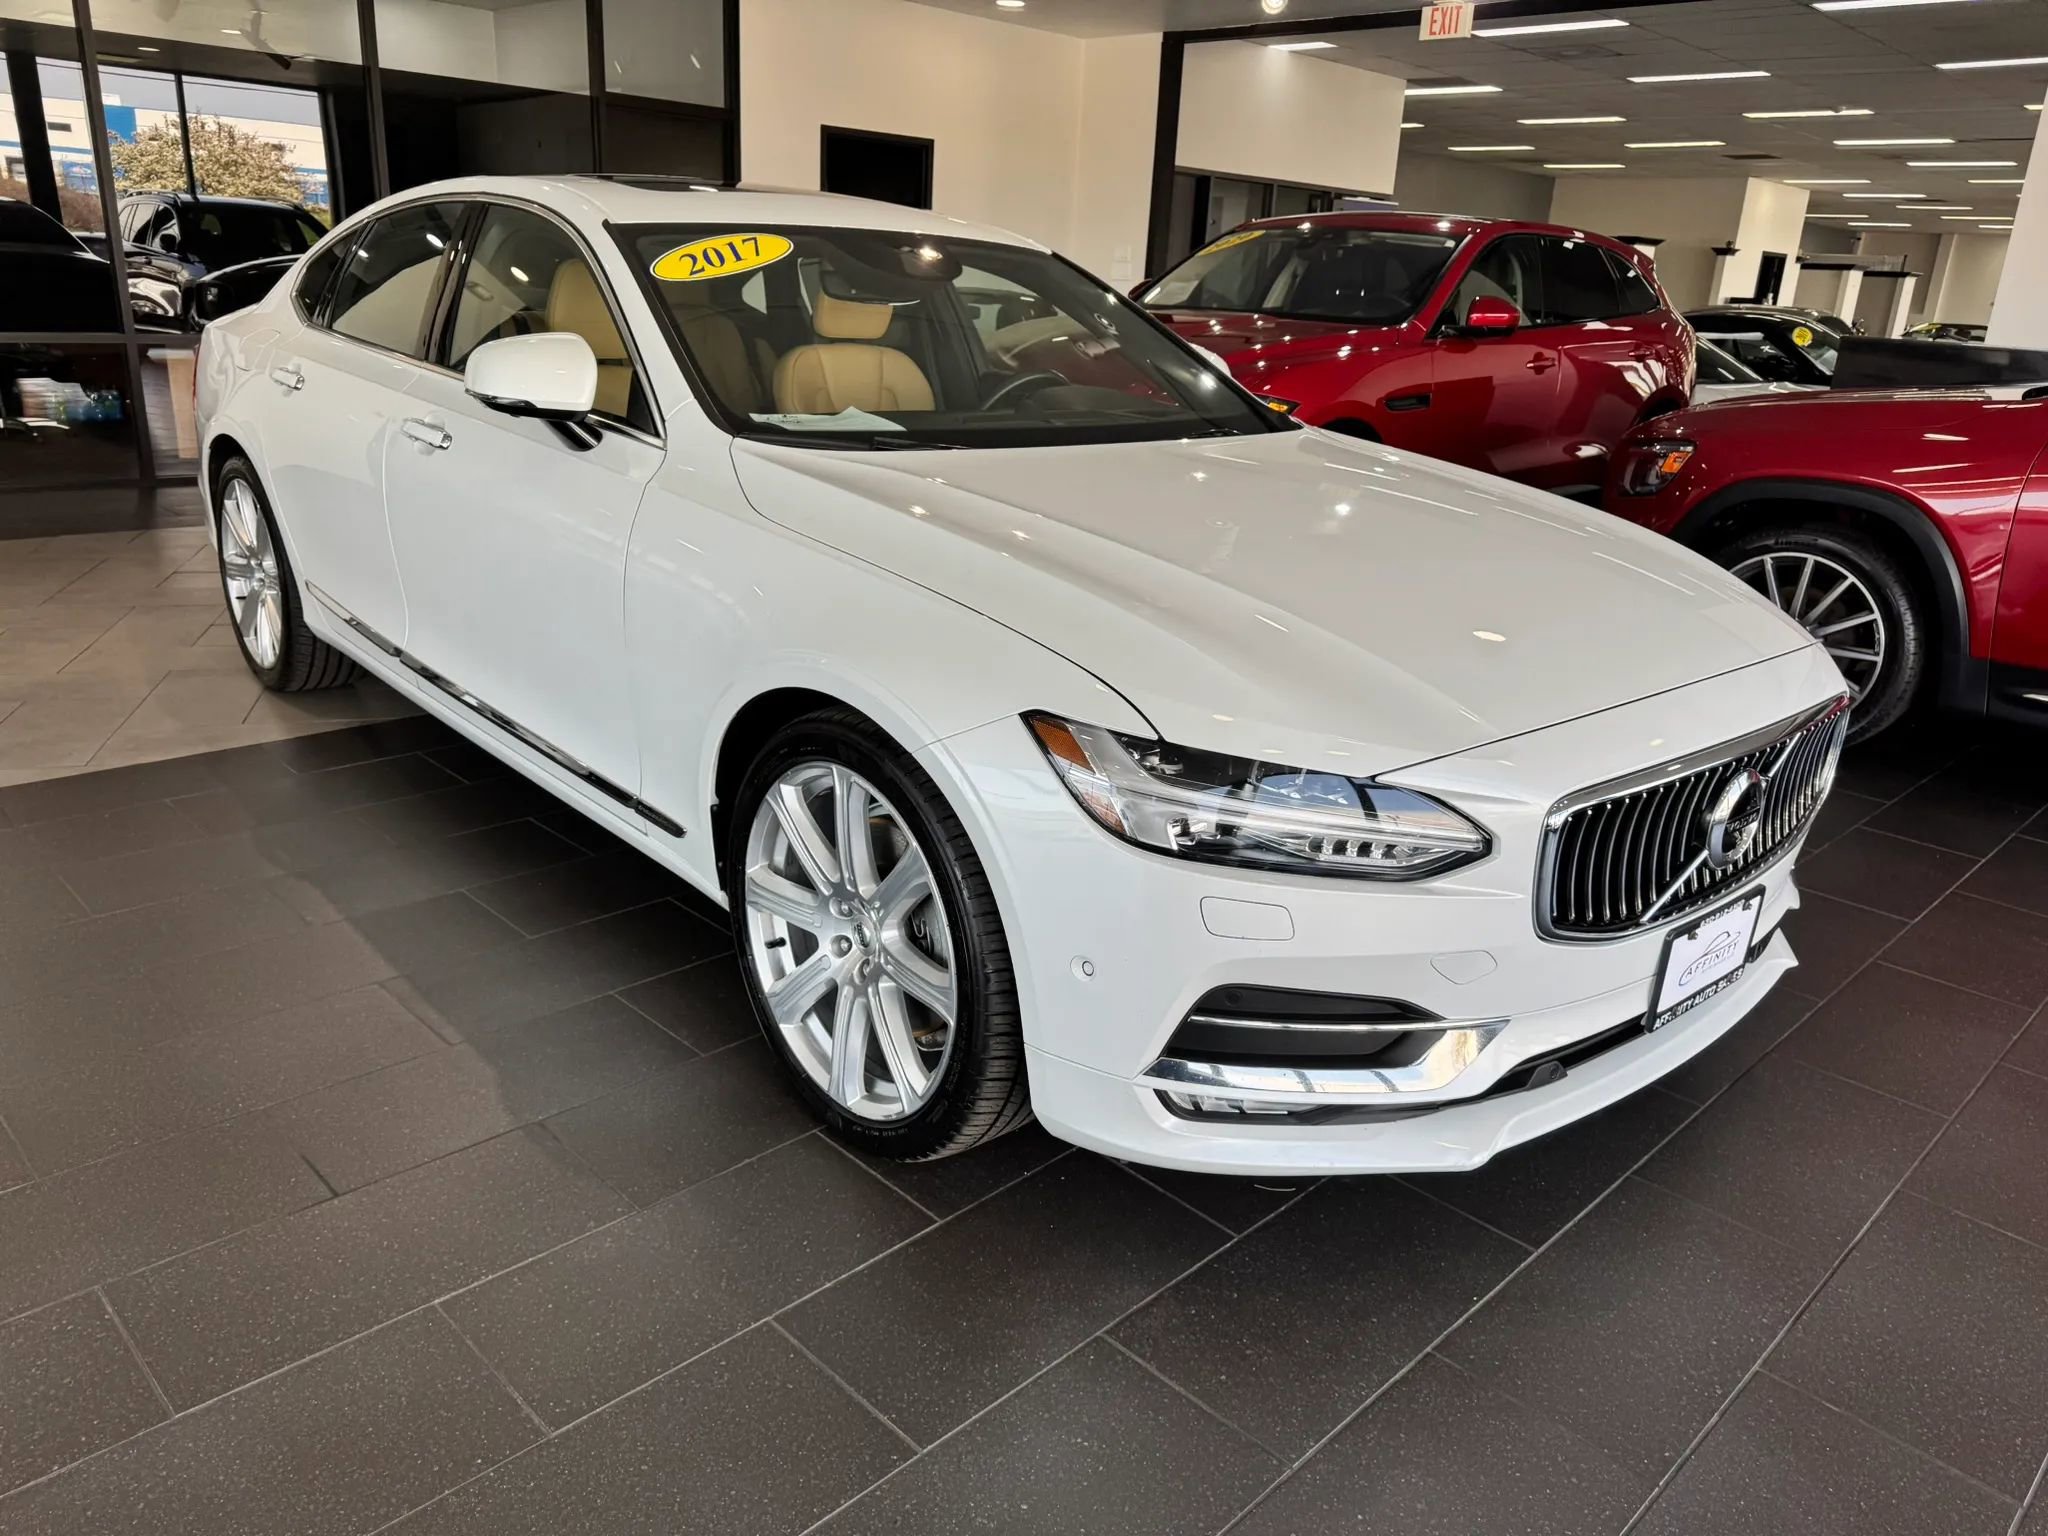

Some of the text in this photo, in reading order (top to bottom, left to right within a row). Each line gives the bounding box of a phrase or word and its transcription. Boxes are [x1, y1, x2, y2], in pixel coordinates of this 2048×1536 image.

[1429, 5, 1463, 36] EXIT
[679, 236, 760, 277] 2017
[1685, 940, 1740, 978] AFFINITY
[1653, 967, 1744, 1030] AFFITY AUTO SAES
